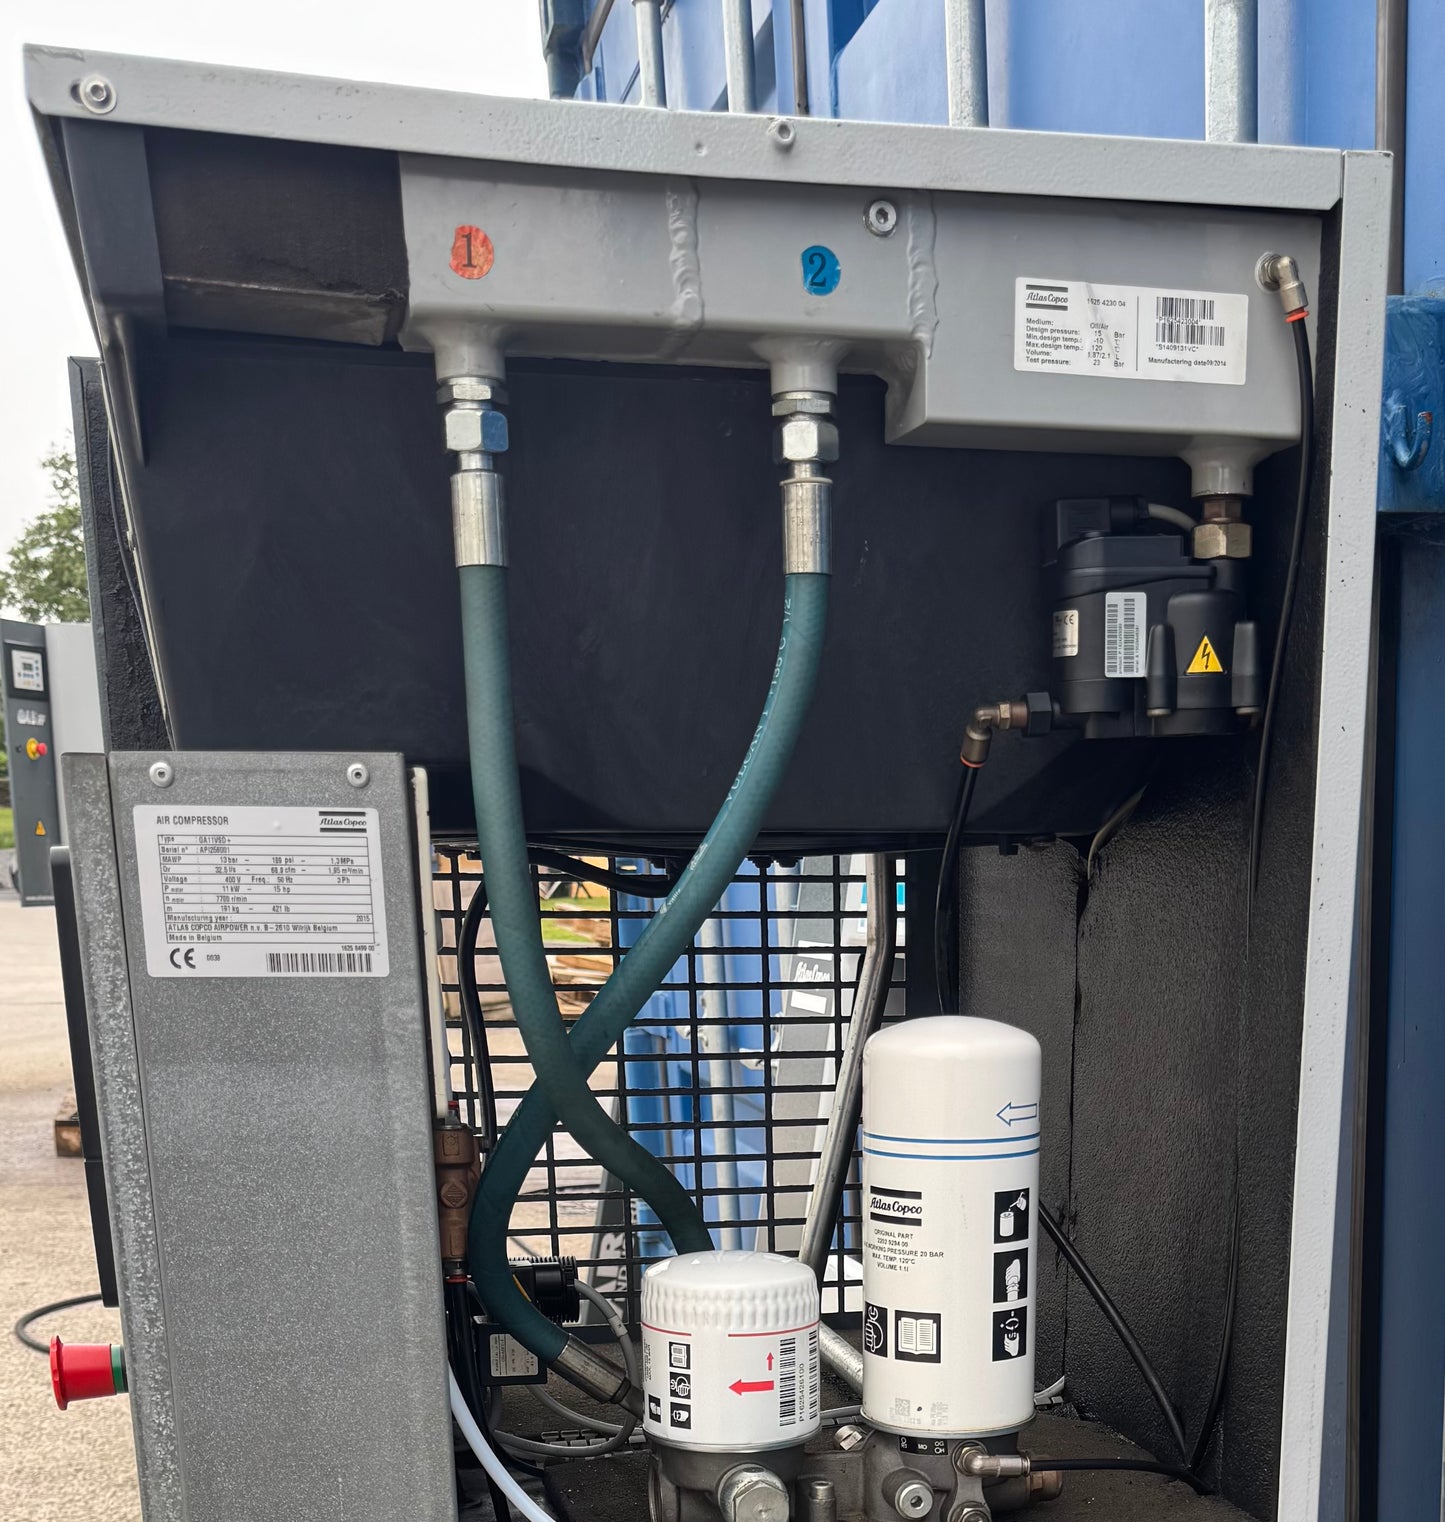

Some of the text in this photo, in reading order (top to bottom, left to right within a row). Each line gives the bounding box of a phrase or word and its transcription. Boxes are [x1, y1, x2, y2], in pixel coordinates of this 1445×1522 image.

[460, 232, 477, 268] 1
[808, 252, 827, 287] 2
[1026, 292, 1069, 304] Atlas Copco
[1026, 317, 1054, 326] Medium:
[1026, 325, 1048, 335] Design
[1050, 327, 1080, 336] pressure:
[1026, 349, 1052, 357] Volume:
[1026, 356, 1040, 364] Test
[1041, 358, 1071, 366] pressure:
[156, 815, 229, 826] AIR COMPRESSOR
[319, 817, 367, 827] Atlas Copco
[160, 835, 175, 844] Type
[162, 855, 182, 863] MAWP
[163, 875, 188, 884] Voltage
[167, 914, 213, 923] Manufacturing
[313, 925, 338, 934] Belgium
[196, 934, 223, 942] Belgium
[870, 1197, 923, 1215] Atlas Copco
[874, 1228, 913, 1240] ORIGINAL PART
[887, 1247, 919, 1257] PRESSURE
[877, 1261, 898, 1271] VOLUME
